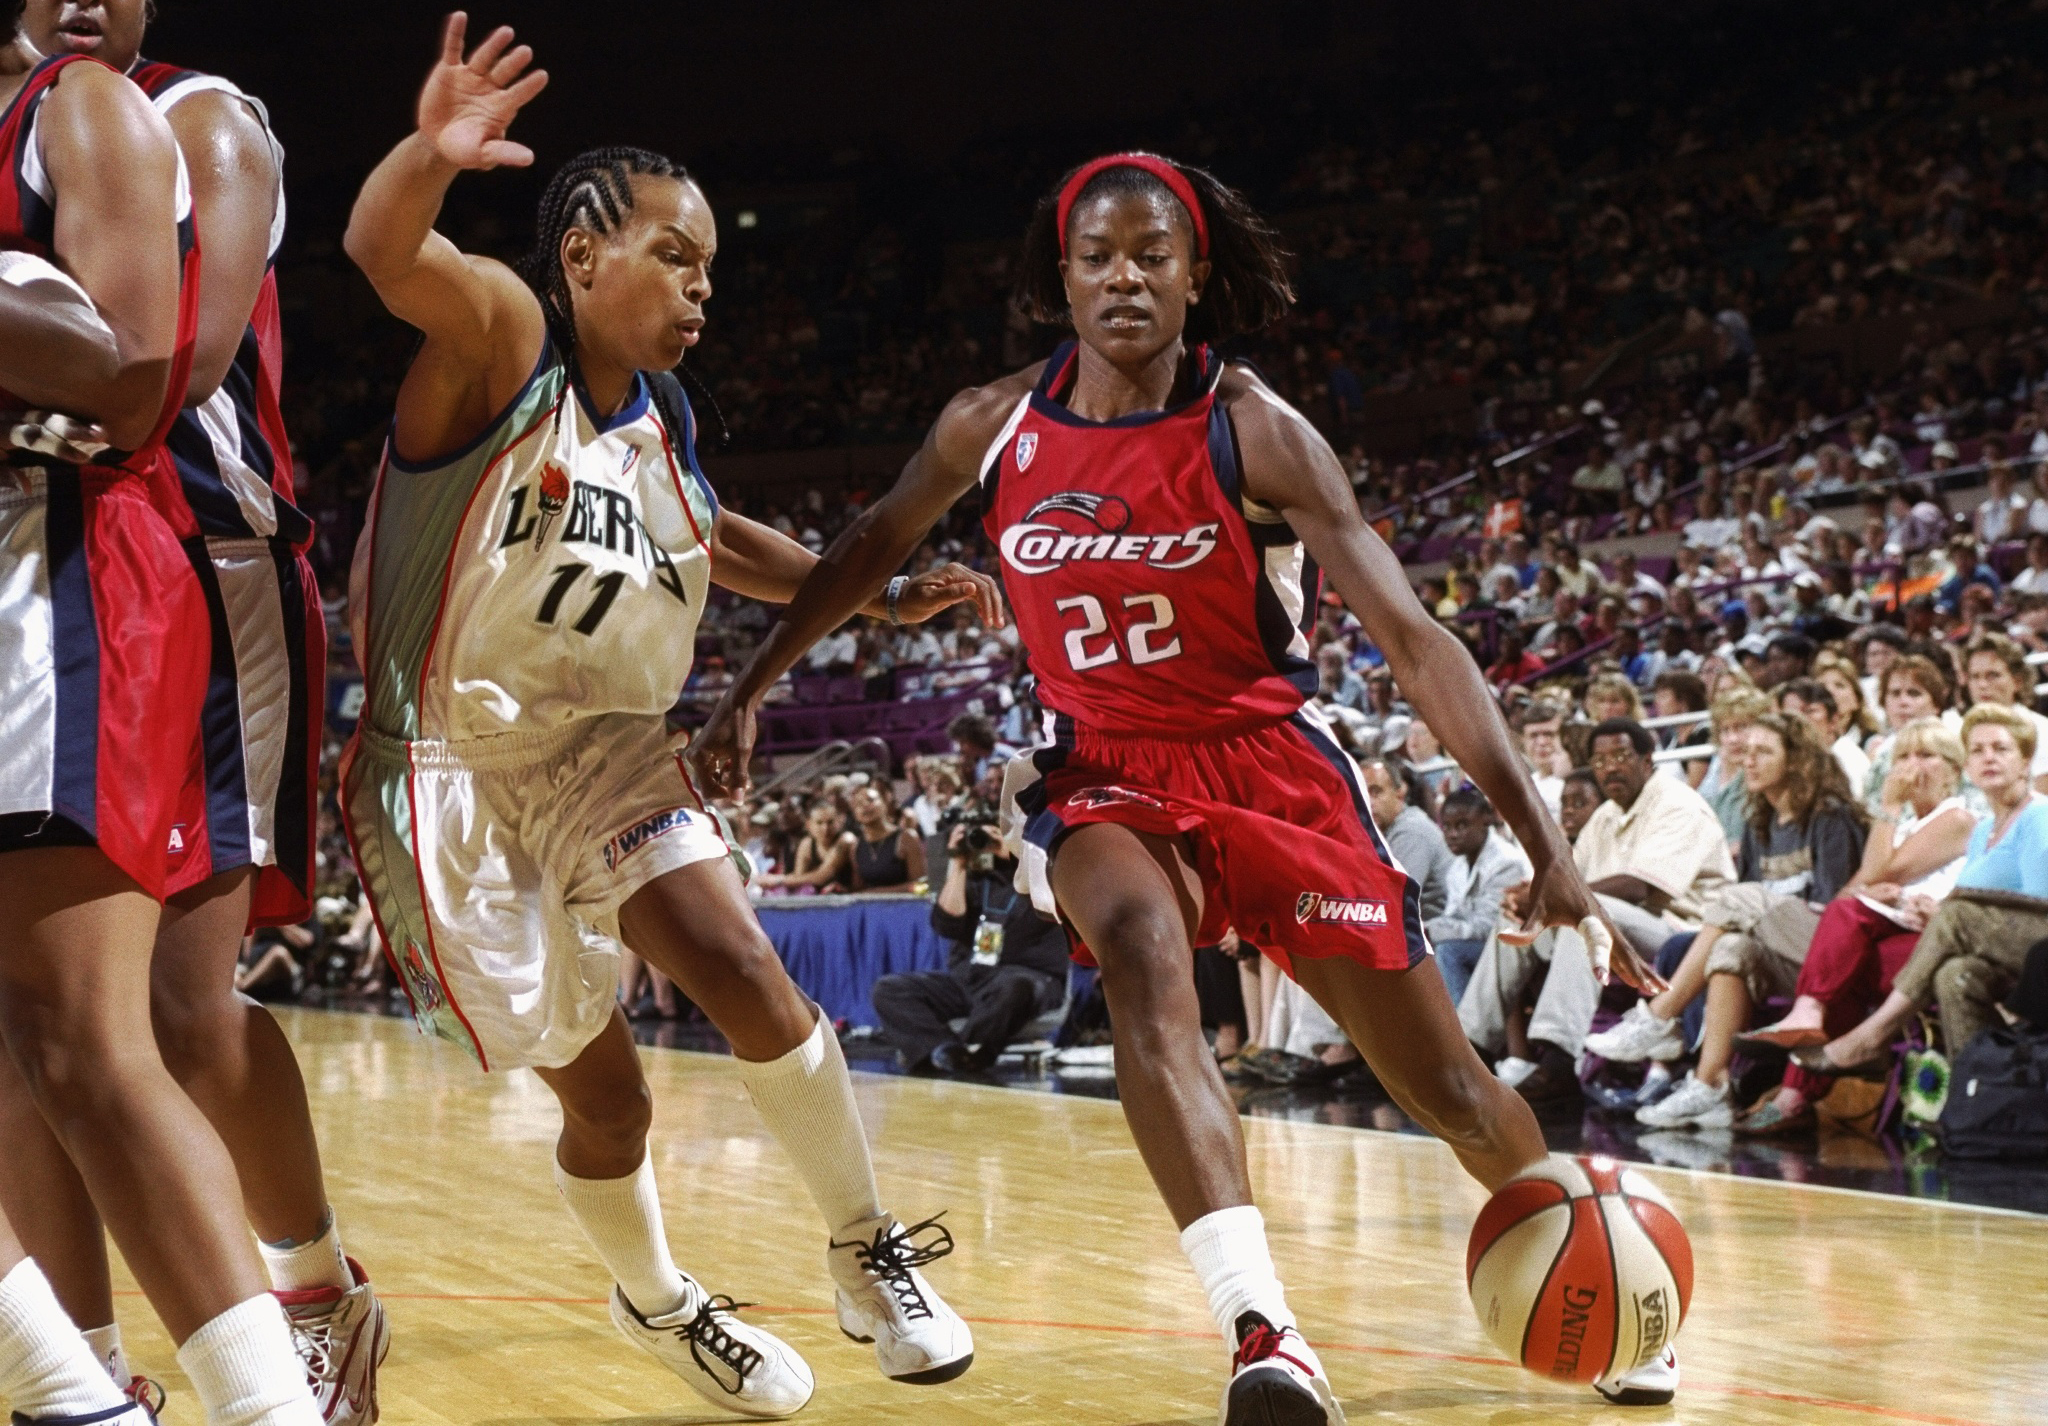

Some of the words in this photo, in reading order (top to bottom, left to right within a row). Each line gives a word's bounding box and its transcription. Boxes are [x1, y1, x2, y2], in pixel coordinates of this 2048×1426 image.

[1000, 522, 1220, 575] COMETS
[534, 562, 627, 637] 11
[1055, 593, 1182, 671] 22
[618, 809, 693, 854] WNBA
[1320, 900, 1388, 923] WNBA
